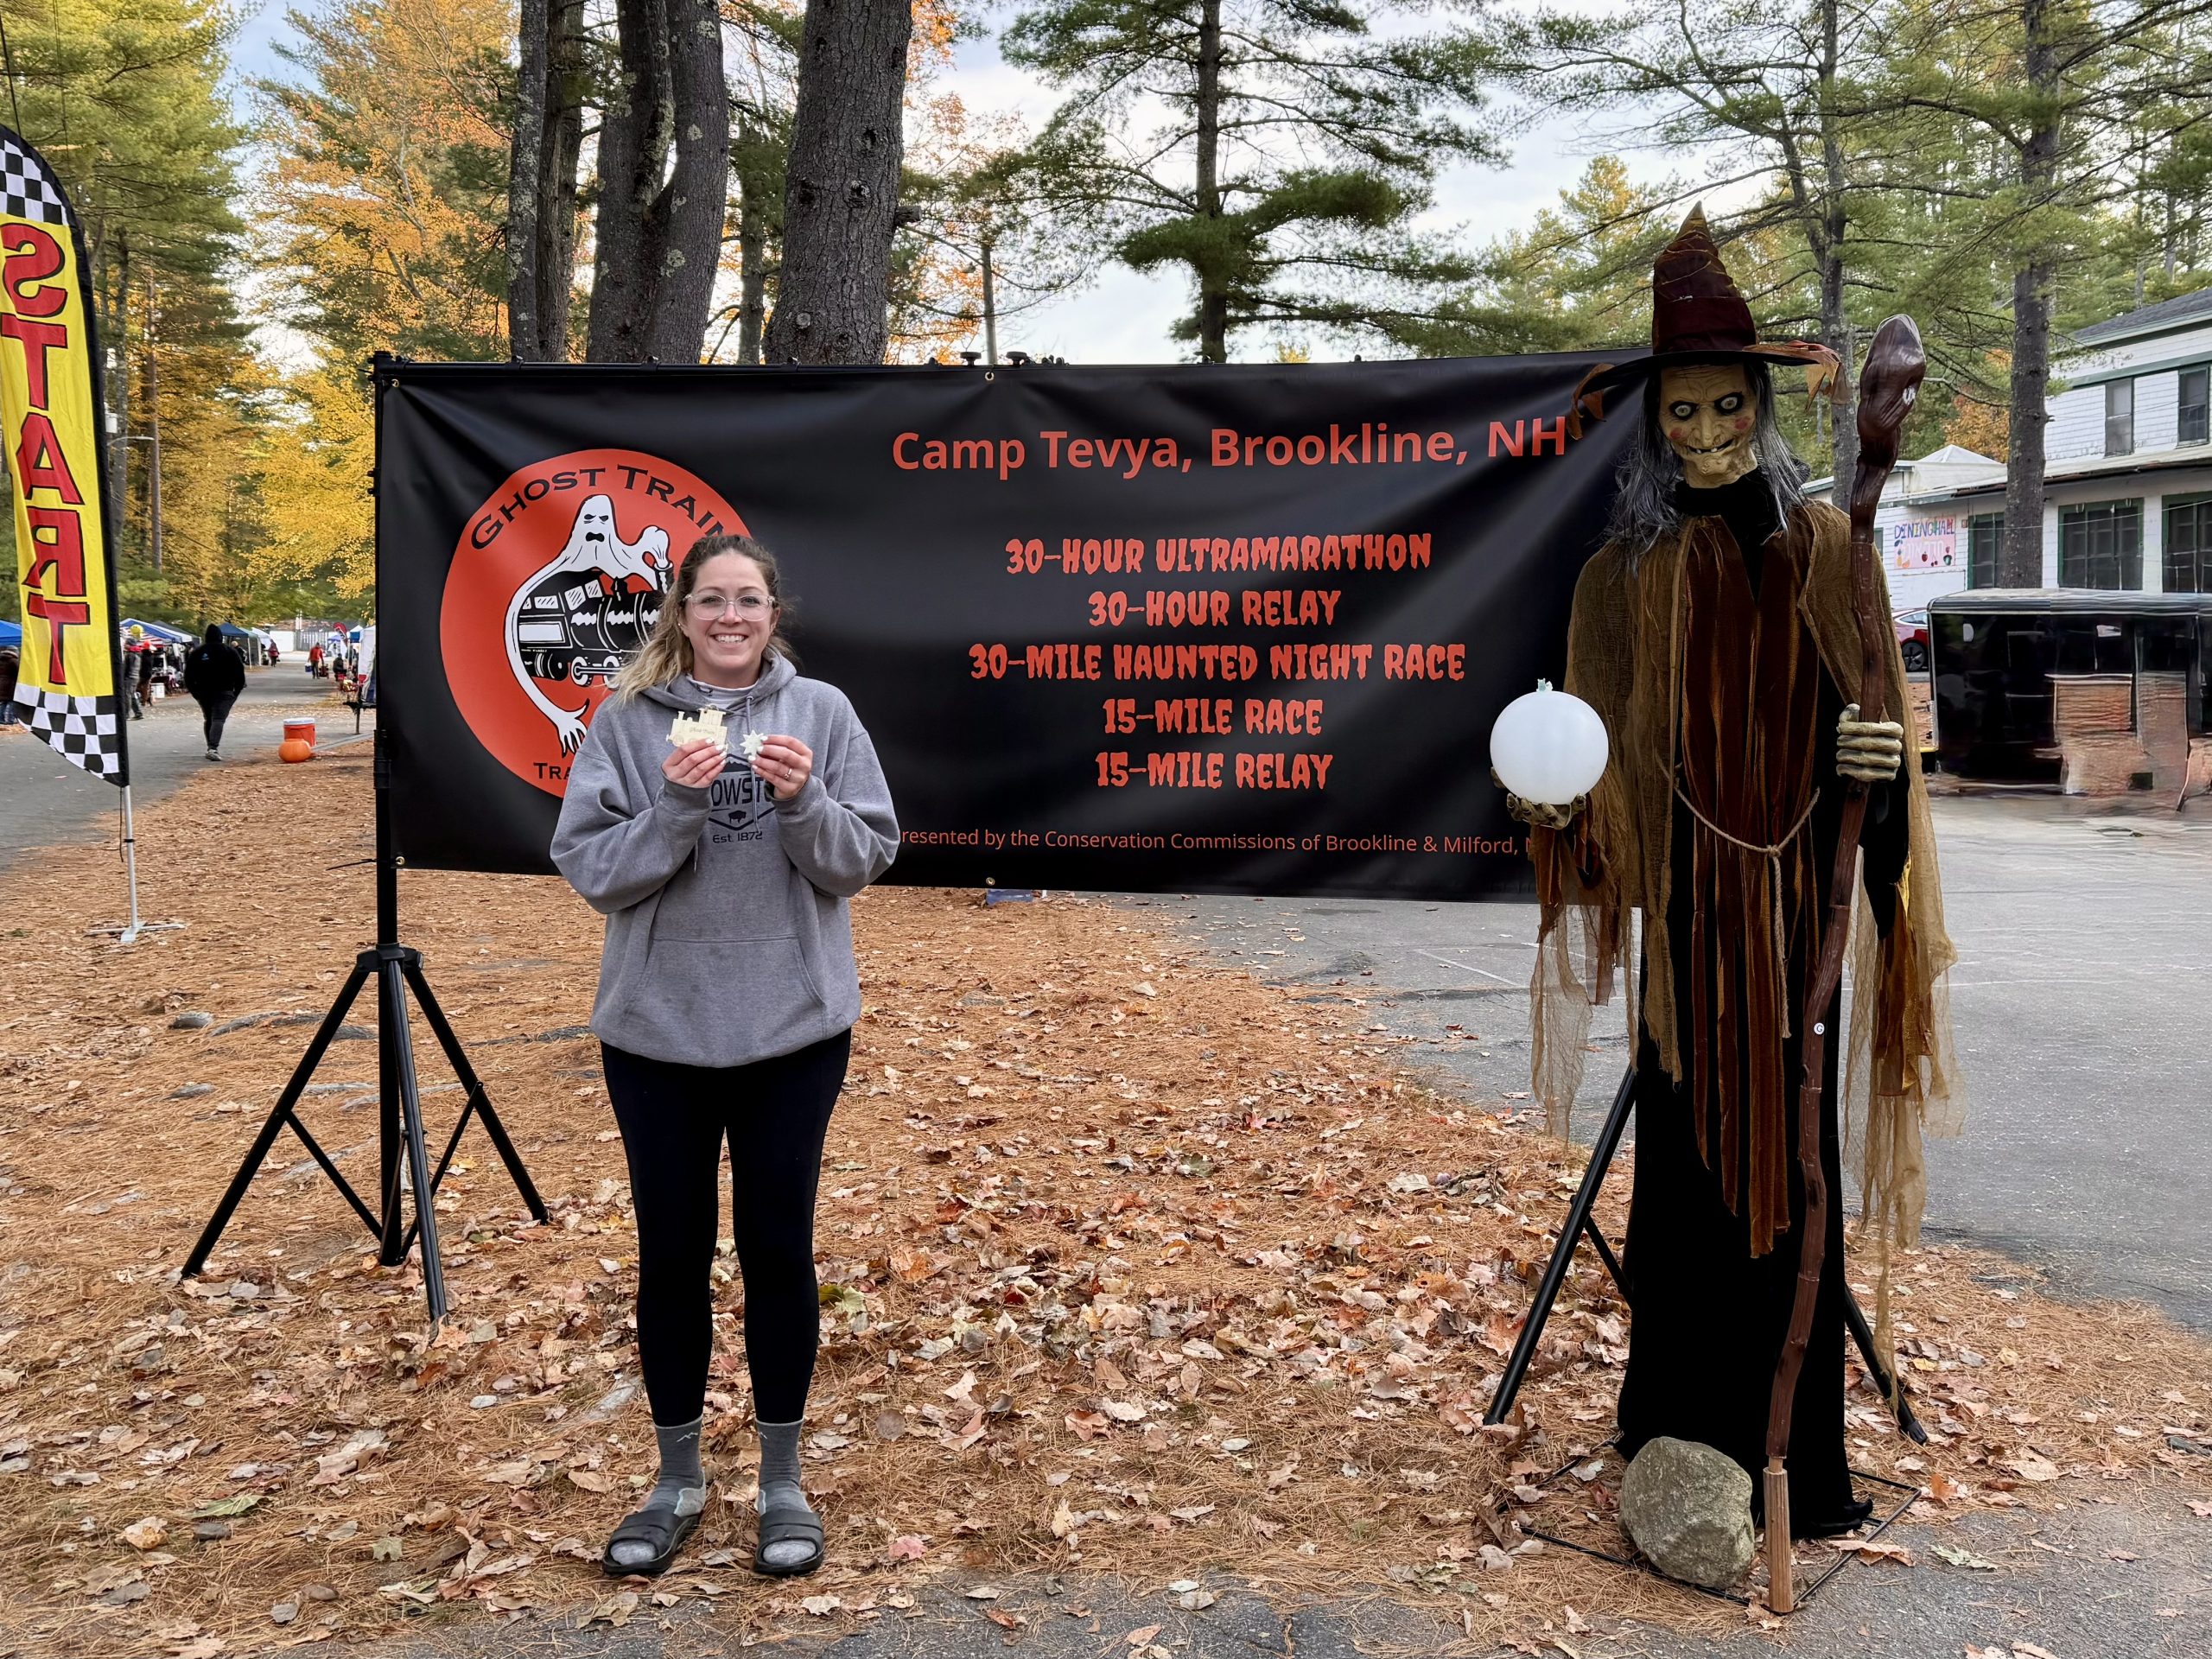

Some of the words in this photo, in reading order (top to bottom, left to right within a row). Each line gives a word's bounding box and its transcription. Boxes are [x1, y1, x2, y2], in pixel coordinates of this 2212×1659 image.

[893, 432, 1026, 480] Camp
[1039, 430, 1192, 480] Tevya,
[1211, 423, 1468, 467] Brookline,
[1488, 416, 1566, 457] NH
[471, 467, 606, 550] GHOST
[1894, 522, 1933, 539] DINING
[1934, 518, 1955, 536] HALL
[1005, 538, 1145, 575] 30-HOUR
[1155, 532, 1432, 573] ULTRAMARATHON
[1088, 590, 1230, 628] 30-HOUR
[1242, 589, 1343, 627] RELAY
[969, 643, 1102, 681] 30-MILE
[1113, 644, 1258, 682] HAUNTED
[1269, 644, 1373, 681] NIGHT
[1383, 644, 1465, 681] RACE
[1103, 698, 1233, 735] 15-MILE
[1244, 698, 1324, 736] RACE
[1096, 751, 1224, 789] 15-MILE
[1236, 753, 1334, 790] RELAY
[737, 830, 763, 842] 1872
[901, 829, 979, 845] resented
[984, 830, 1006, 849] by
[1010, 830, 1039, 847] the
[1045, 830, 1165, 849] Conservation
[1171, 833, 1296, 850] Commissions
[1301, 834, 1321, 851] of
[1326, 835, 1418, 852] Brookline
[1423, 836, 1438, 853] &
[1444, 836, 1518, 855] Milford,
